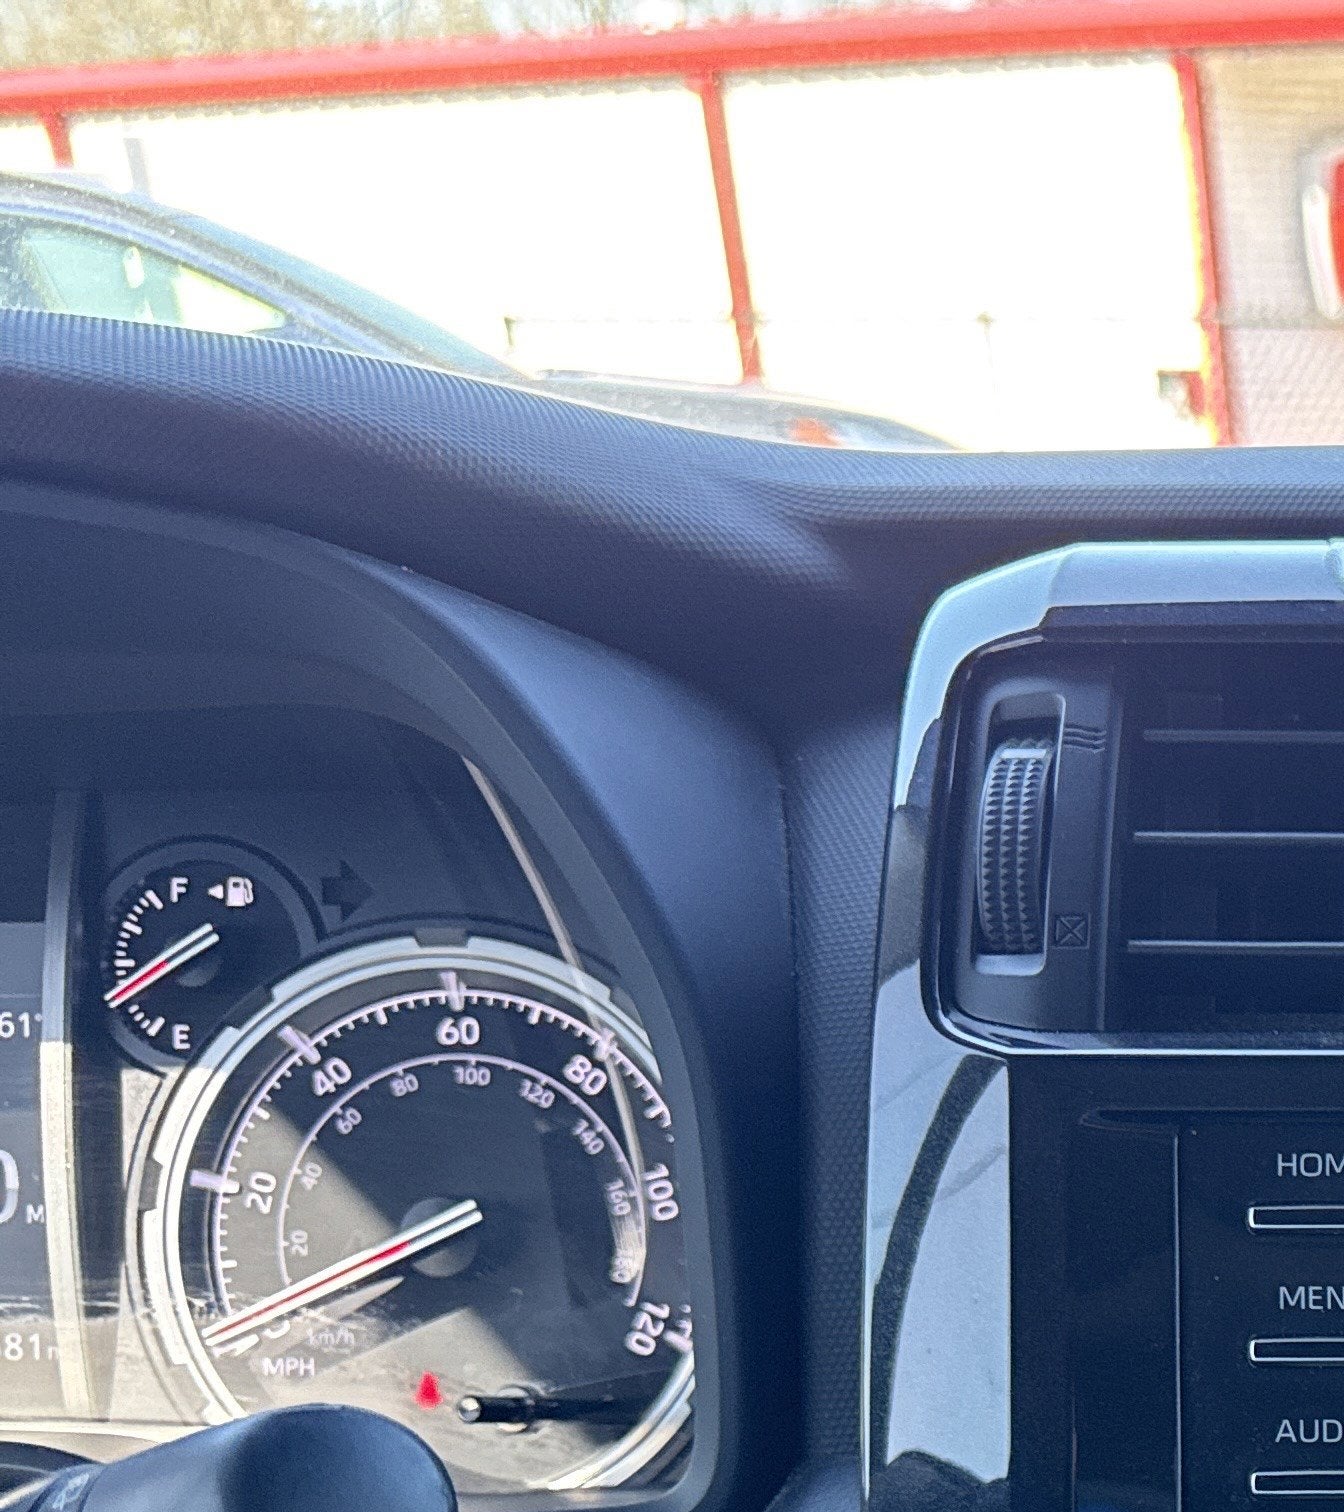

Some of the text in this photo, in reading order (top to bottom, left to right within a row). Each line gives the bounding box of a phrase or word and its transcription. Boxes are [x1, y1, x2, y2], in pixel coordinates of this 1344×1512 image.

[169, 876, 190, 904] F
[171, 1022, 192, 1051] E
[436, 1015, 481, 1046] 60
[312, 1056, 352, 1096] 40
[389, 1072, 419, 1098] 80
[452, 1065, 492, 1087] 100
[562, 1053, 608, 1096] 80
[519, 1078, 555, 1109] 120
[335, 1106, 363, 1135] 60
[572, 1118, 605, 1155] 140
[301, 1161, 323, 1191] 40
[245, 1171, 277, 1215] 20
[643, 1162, 680, 1222] 100
[289, 1229, 309, 1257] 20
[623, 1302, 671, 1357] 120
[261, 1356, 316, 1377] MPH
